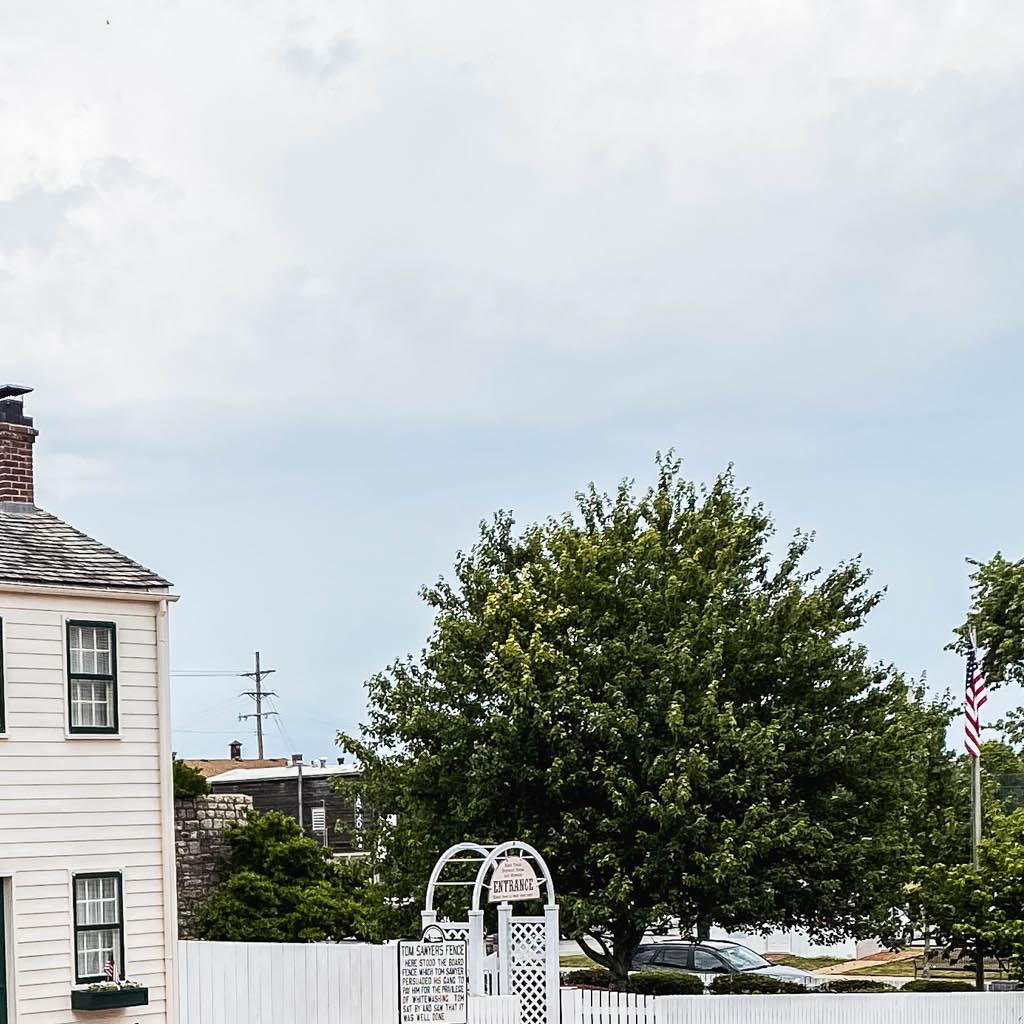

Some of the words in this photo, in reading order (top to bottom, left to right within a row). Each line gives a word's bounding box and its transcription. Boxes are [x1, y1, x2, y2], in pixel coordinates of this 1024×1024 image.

[493, 878, 534, 893] ENTRANCE
[401, 945, 414, 956] TOM
[445, 944, 465, 956] FENCE
[405, 959, 417, 967] HERE
[419, 959, 436, 967] STOOD
[437, 958, 447, 966] THE
[448, 958, 465, 966] BOARD
[402, 968, 417, 976] FENCE
[419, 968, 433, 976] WHICH
[435, 968, 445, 976] TOM
[446, 967, 464, 976] SAWYER
[402, 977, 432, 986] PERSUADED
[433, 976, 442, 985] HIS
[443, 976, 456, 985] GANG
[458, 976, 465, 984] TO
[402, 987, 410, 995] PAY
[411, 986, 420, 994] HIM
[421, 986, 431, 994] FOR
[432, 986, 441, 994] THE
[442, 985, 464, 994] PRIVILEGE
[403, 996, 410, 1004] OF
[454, 994, 465, 1002] TOM
[403, 1005, 412, 1013] SAT
[414, 1004, 421, 1012] BY
[422, 1004, 432, 1012] AND
[433, 1004, 443, 1012] SAW
[445, 1003, 458, 1011] THAT
[458, 1003, 465, 1011] IT
[403, 1014, 414, 1022] WAS
[416, 1013, 430, 1021] WELL
